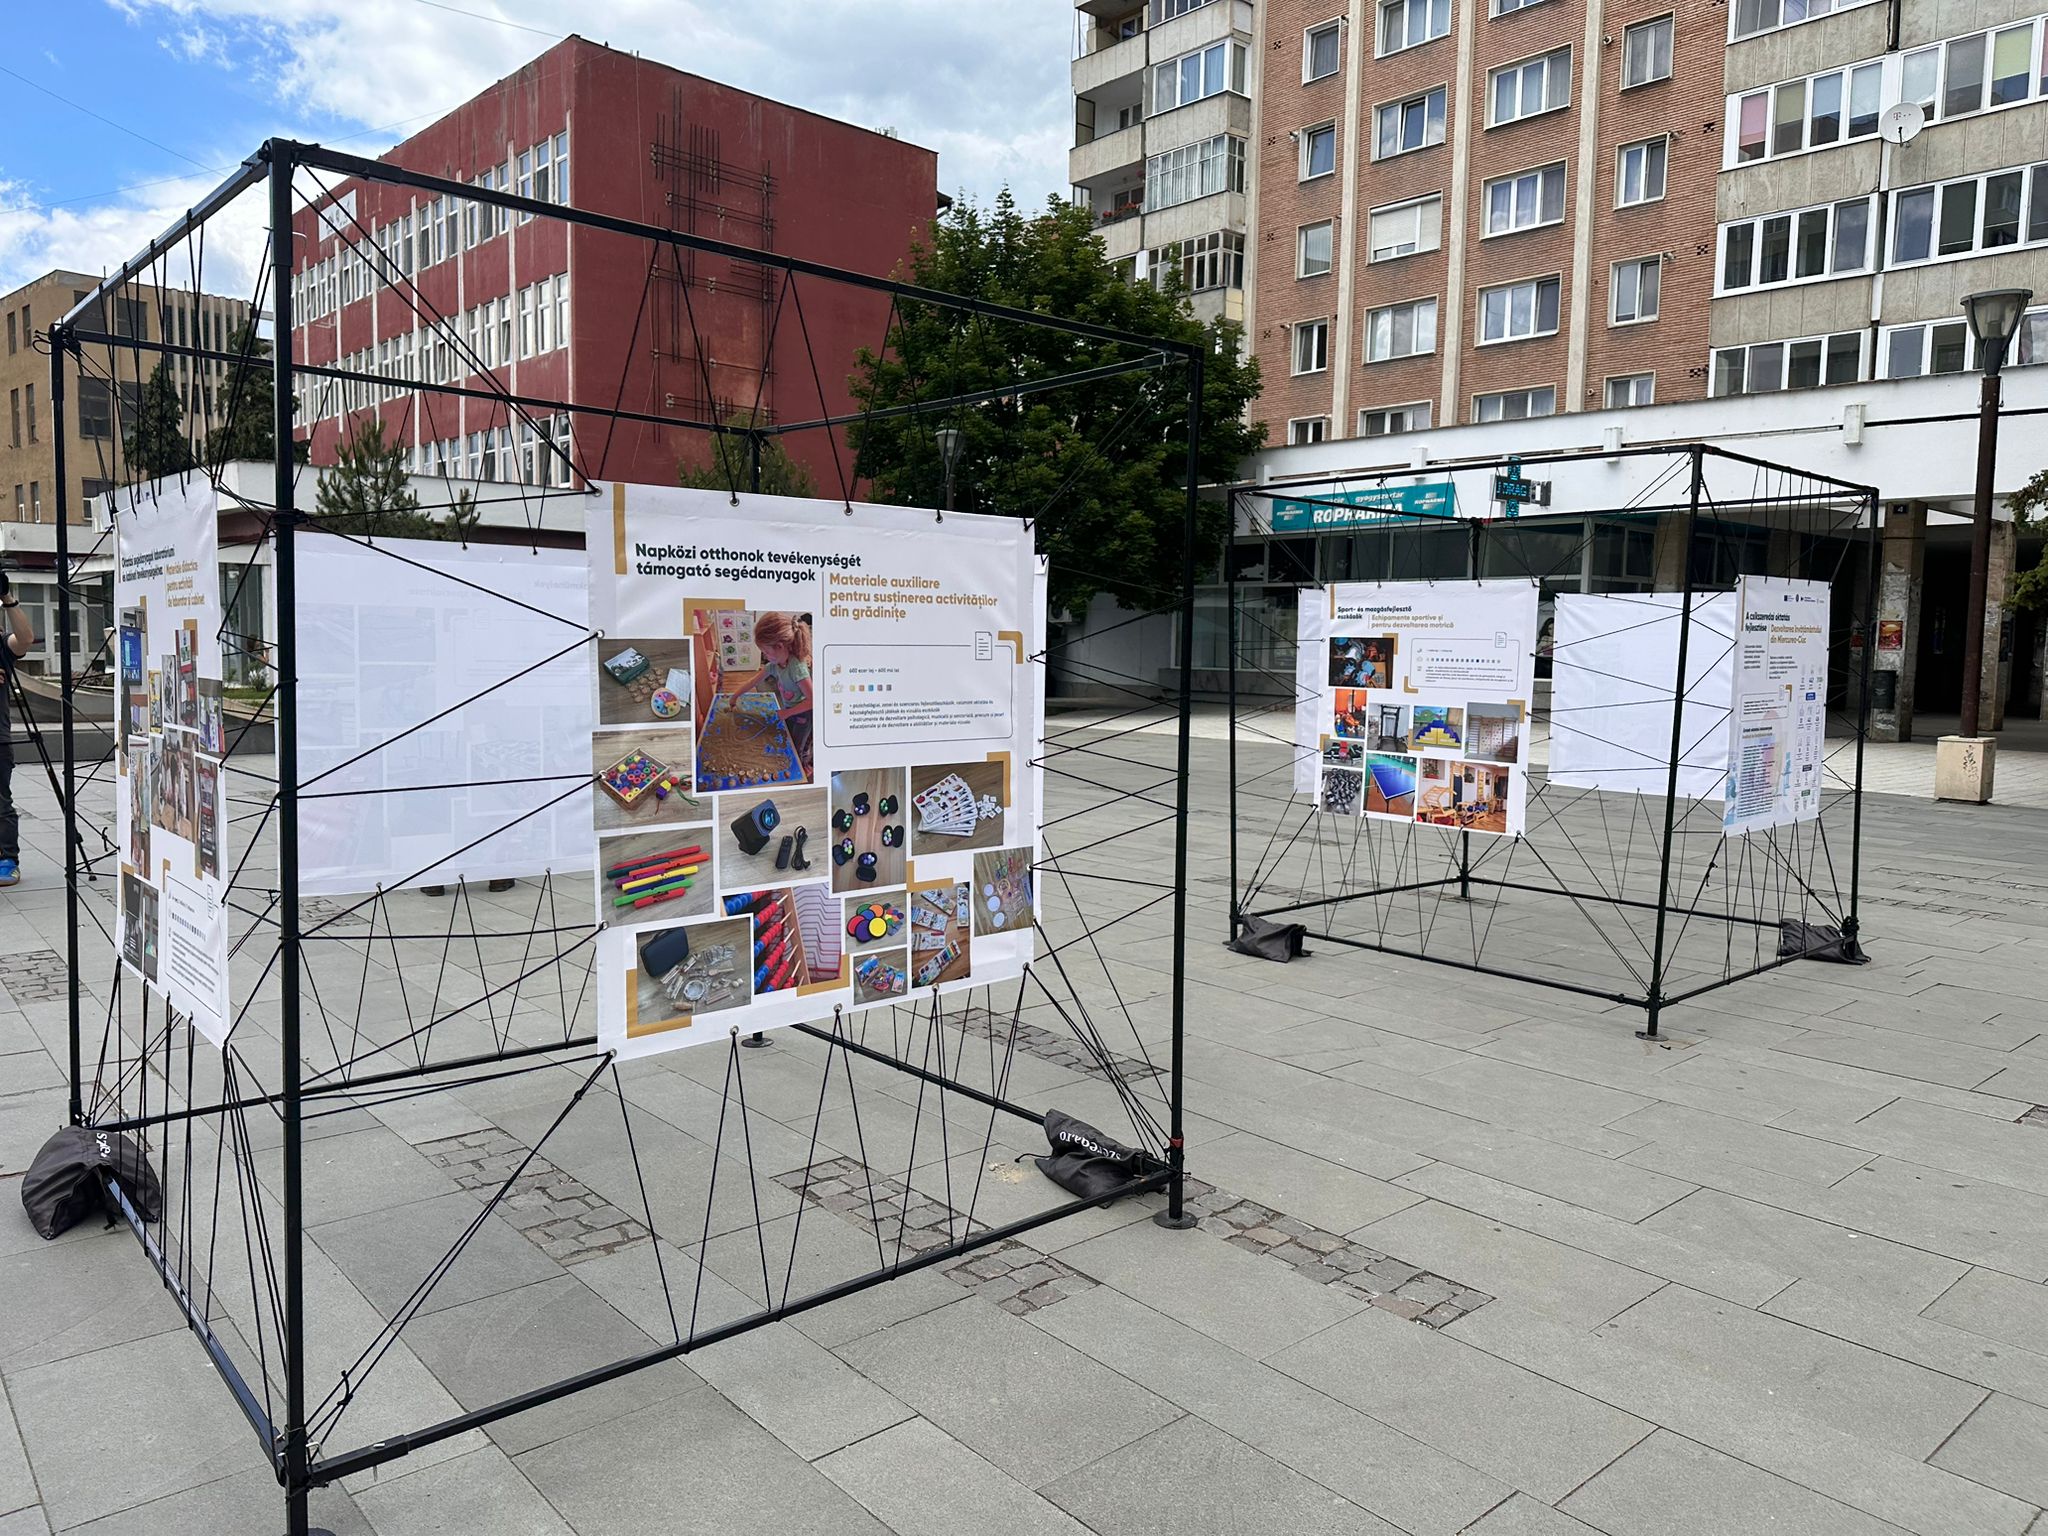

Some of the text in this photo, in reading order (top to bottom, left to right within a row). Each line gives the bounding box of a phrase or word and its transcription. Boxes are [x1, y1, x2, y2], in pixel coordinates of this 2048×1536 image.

[1314, 504, 1402, 524] ROPHARMA
[635, 543, 861, 570] Napközi otthonok tevékenységét
[636, 562, 816, 584] támogató segédanyagok
[830, 572, 940, 589] Materiale auxiliare
[830, 591, 998, 609] pentru susținerea activităților
[830, 606, 906, 622] din grădinițe
